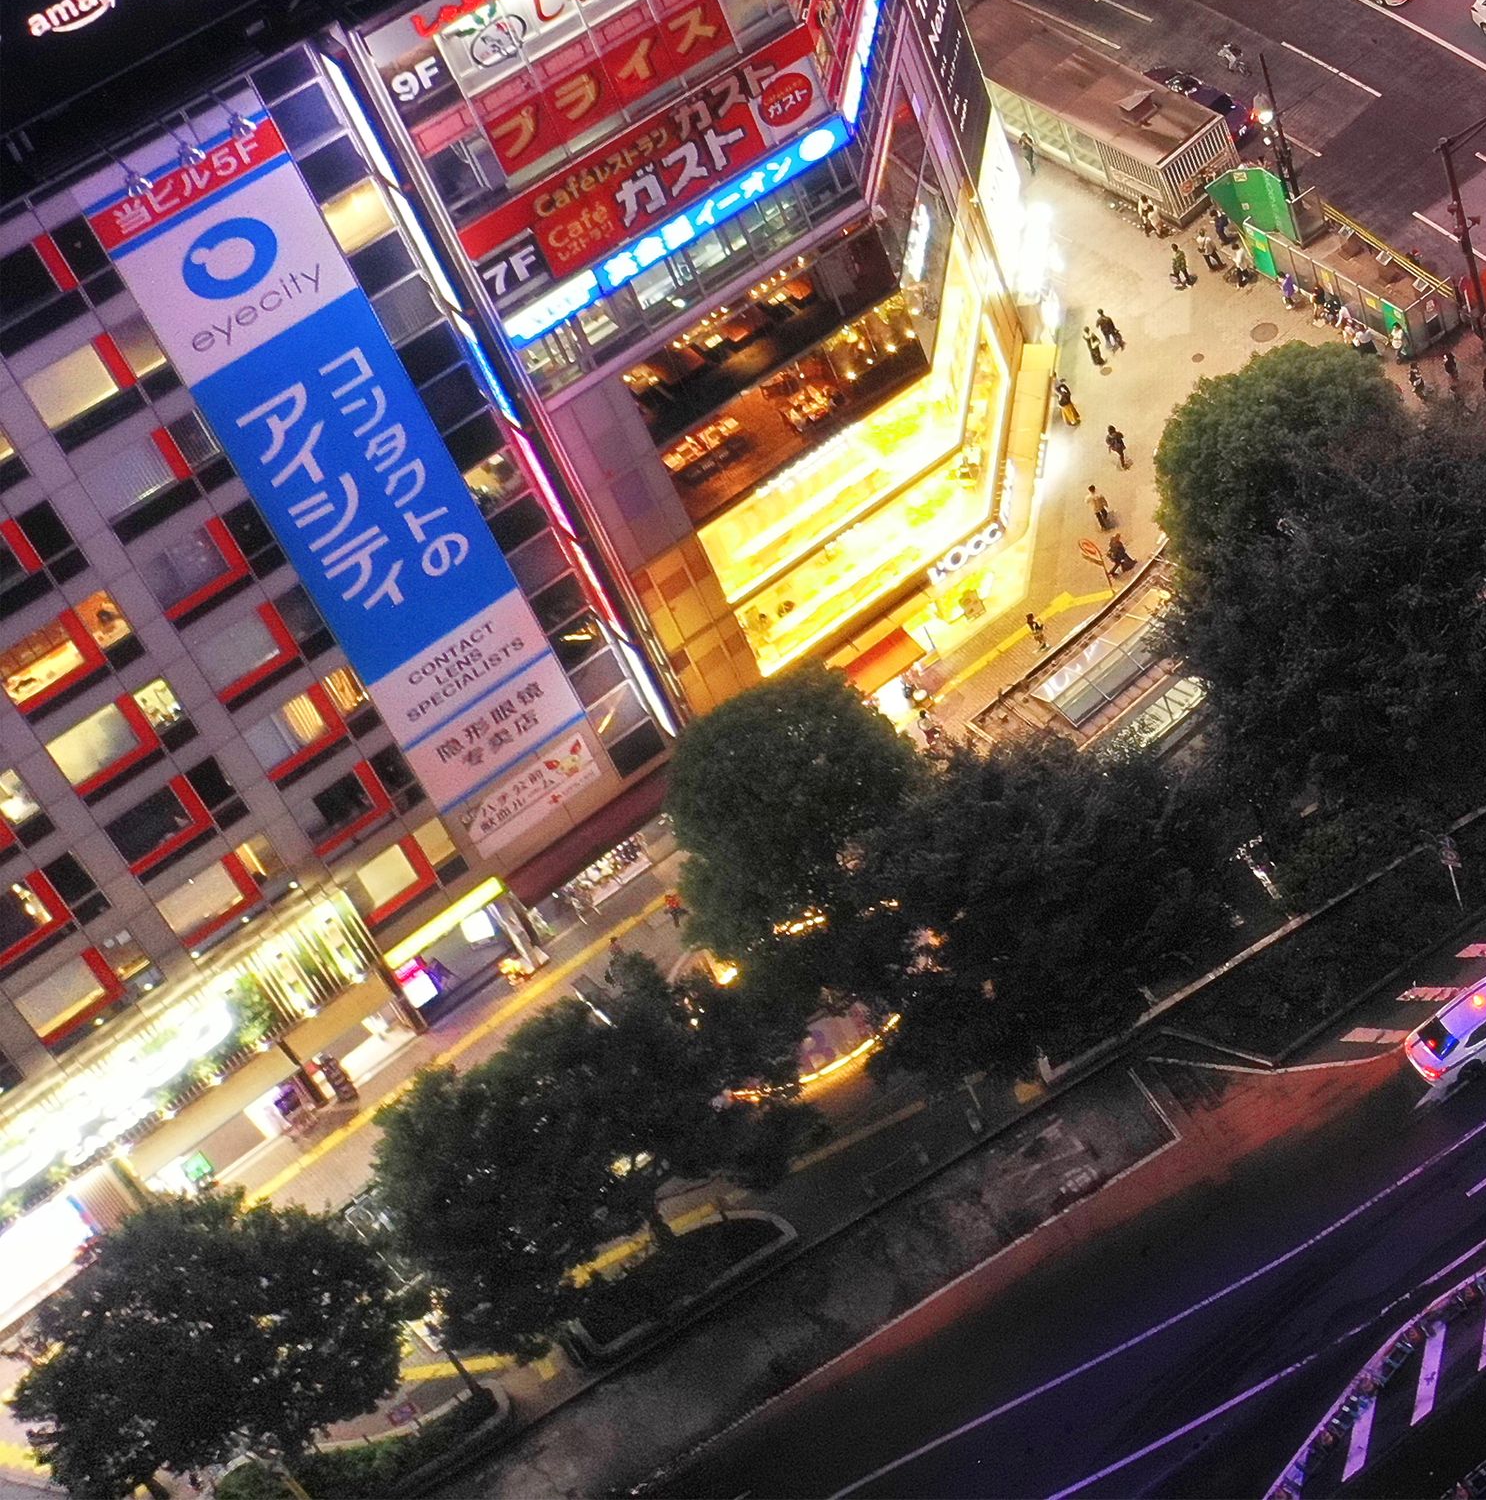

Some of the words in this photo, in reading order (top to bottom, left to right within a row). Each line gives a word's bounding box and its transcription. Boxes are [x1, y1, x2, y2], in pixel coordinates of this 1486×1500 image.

[390, 55, 443, 103] 9F
[766, 83, 812, 122] ガスト
[113, 135, 260, 234] 当ビル5F
[616, 118, 747, 229] ガスト
[191, 260, 325, 360] eyecity
[482, 251, 538, 296] 7F
[236, 381, 405, 610] アイシティ
[320, 347, 470, 578] コンタクトの
[406, 619, 498, 687] CONTACT
[406, 635, 526, 725] SPECIALISTS
[433, 648, 485, 693] LENS
